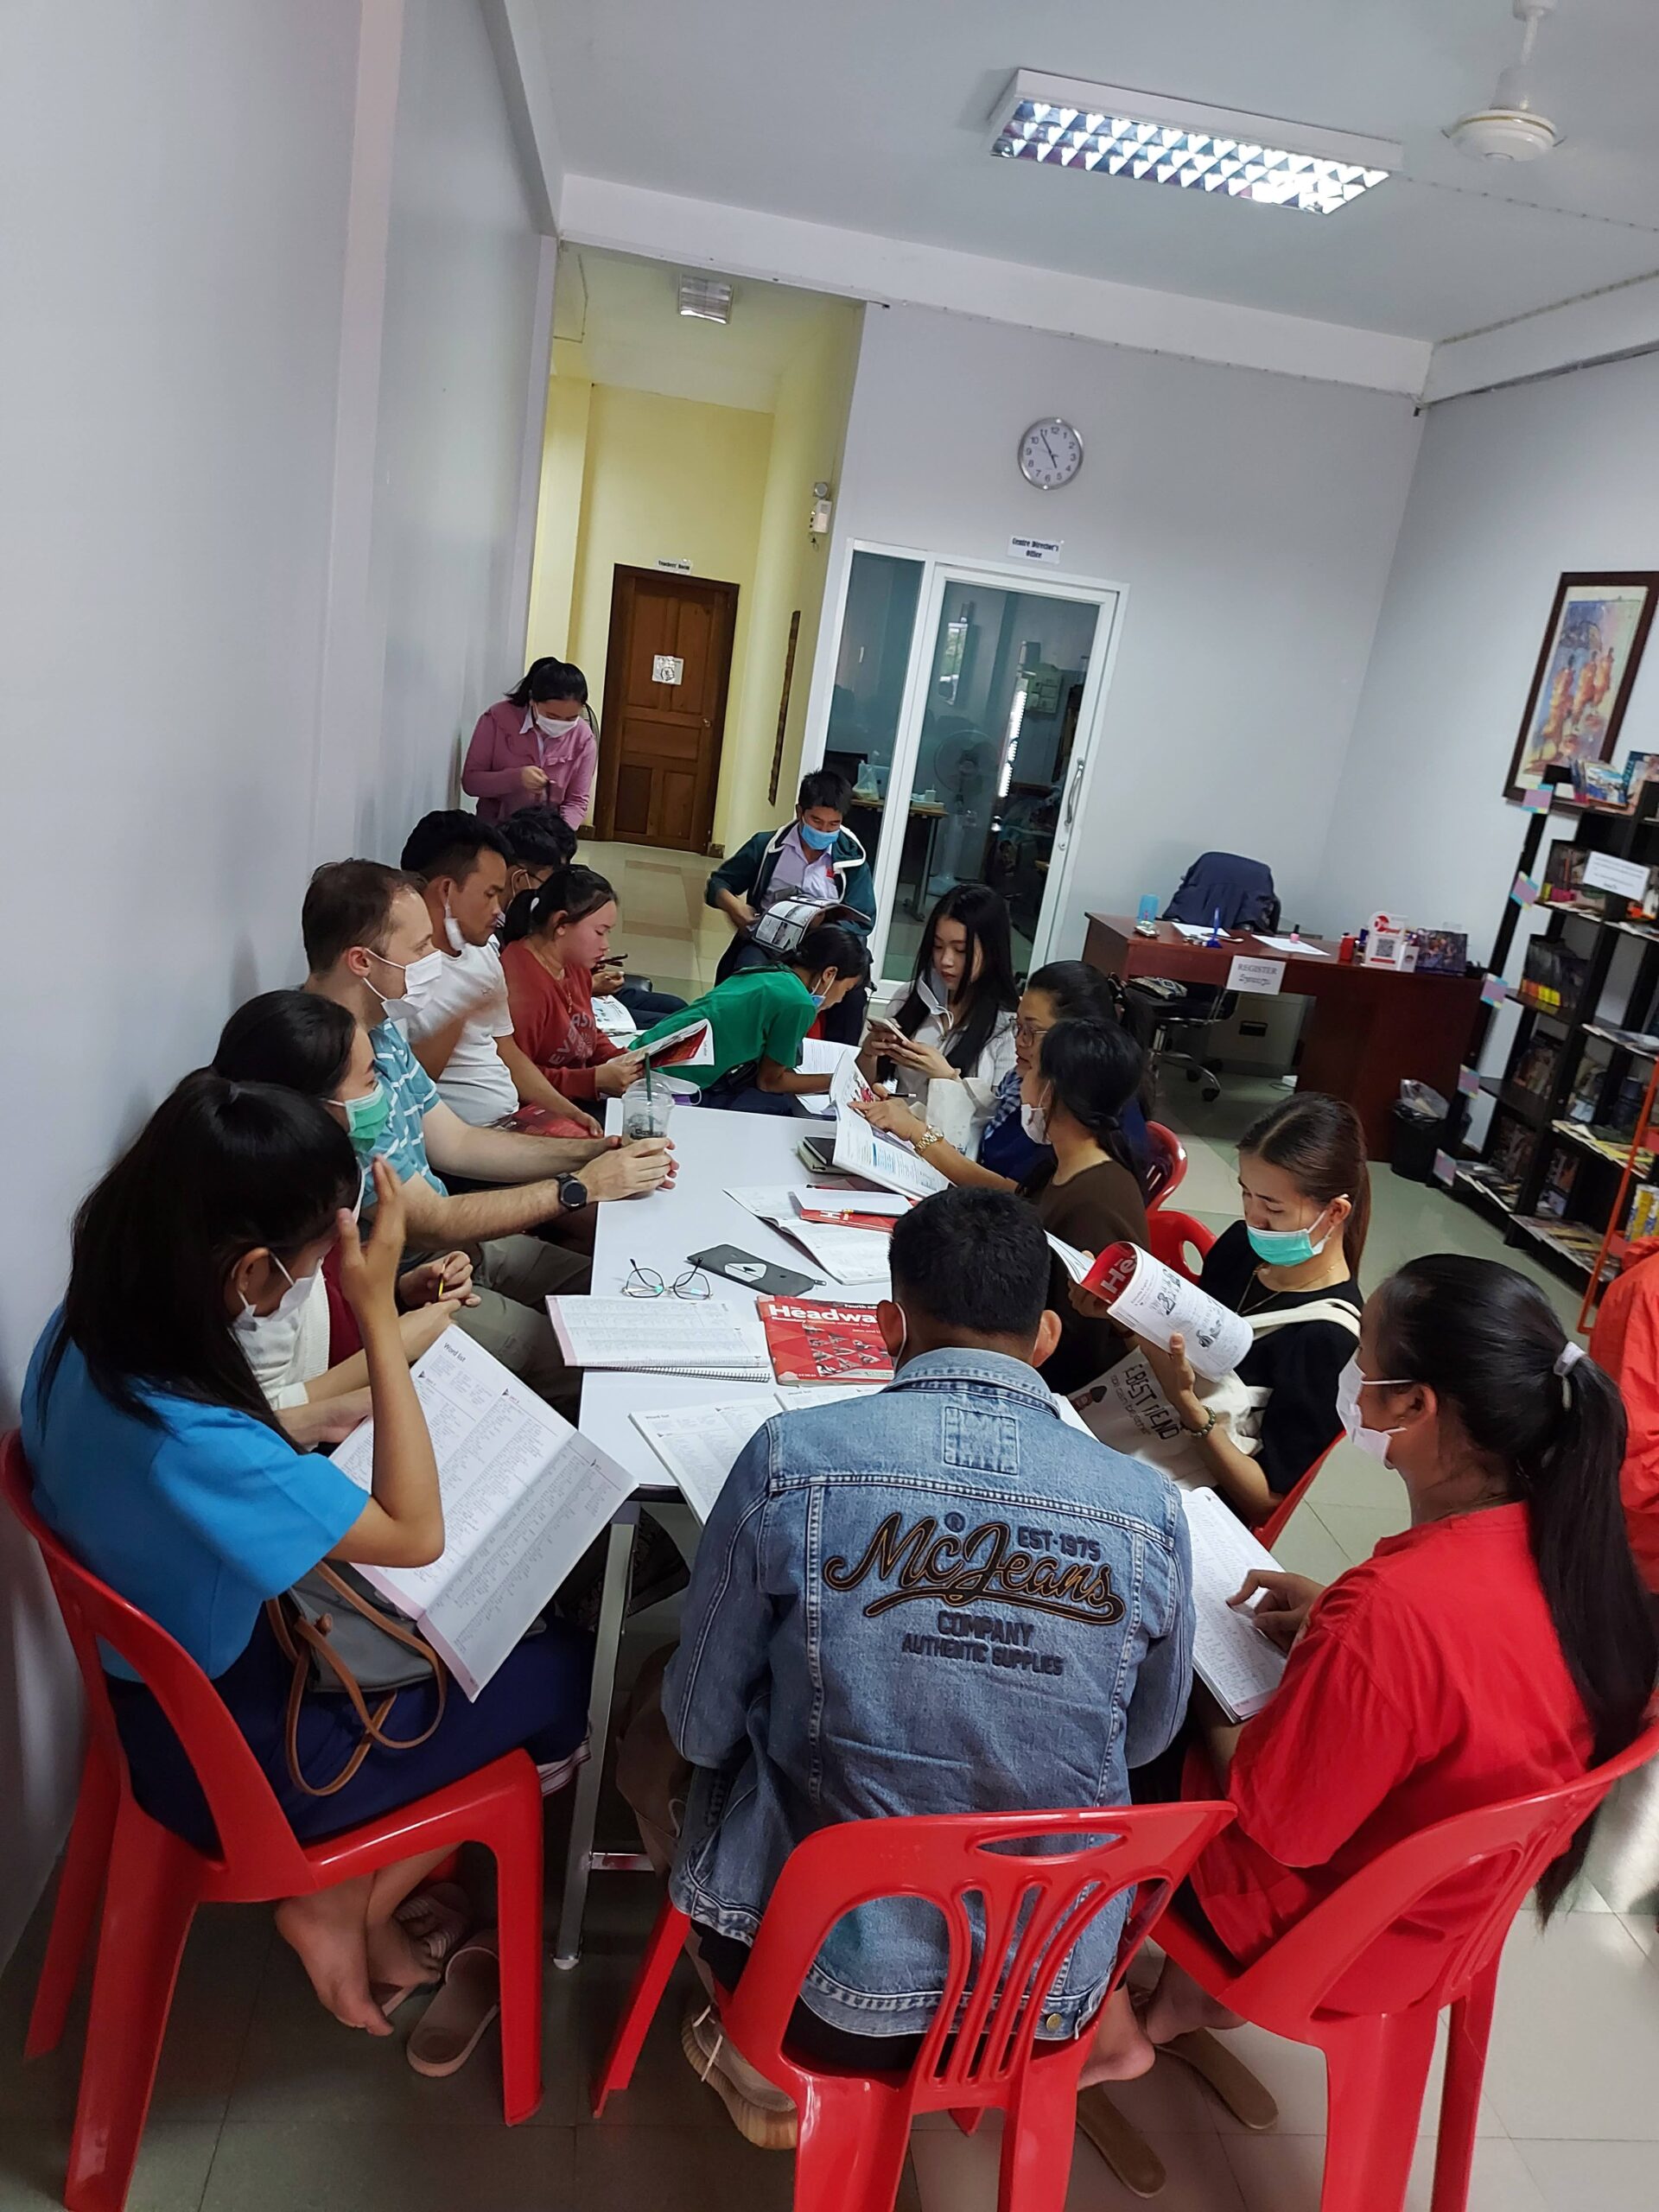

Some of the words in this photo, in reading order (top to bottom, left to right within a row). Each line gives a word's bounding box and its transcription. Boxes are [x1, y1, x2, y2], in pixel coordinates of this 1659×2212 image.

[1237, 963, 1278, 976] REGISTER
[768, 1304, 879, 1324] Headwa
[443, 1342, 459, 1357] Word
[457, 1353, 467, 1363] list
[824, 1512, 1115, 1612] McJeans
[937, 1610, 1035, 1648] COMPANY
[901, 1633, 988, 1664] AUTHENTIC
[992, 1642, 1065, 1676] SUPPLIES
